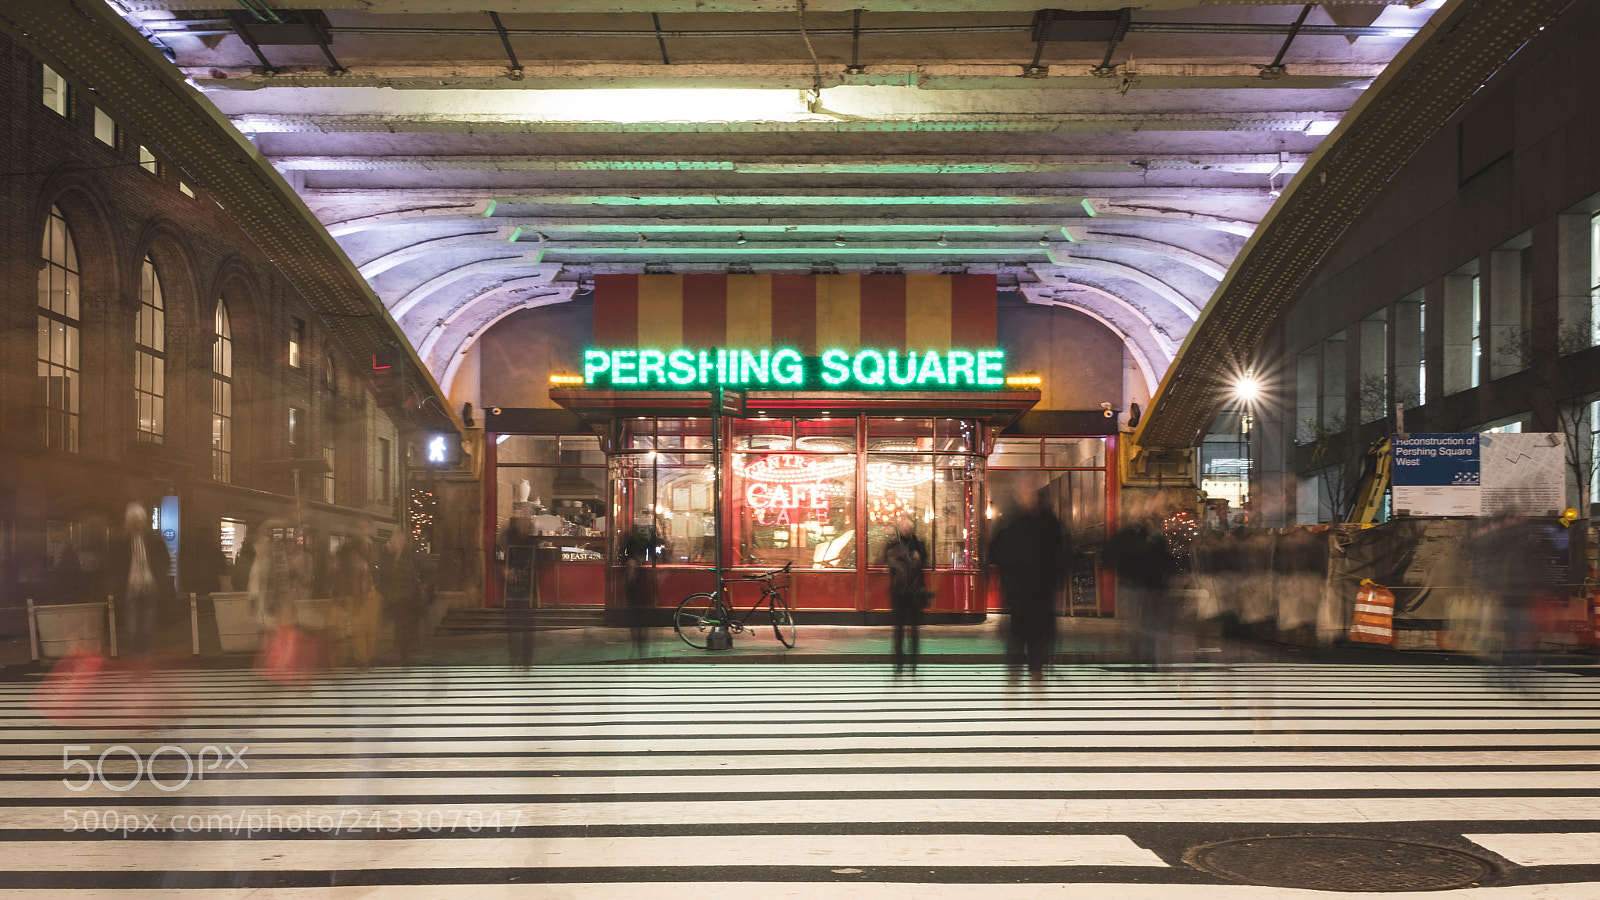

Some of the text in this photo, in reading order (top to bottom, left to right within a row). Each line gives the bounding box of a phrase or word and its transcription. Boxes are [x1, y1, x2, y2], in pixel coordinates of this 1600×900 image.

[584, 348, 1005, 386] PERSHING SQUARE
[1395, 436, 1477, 446] Reconstruction of
[1395, 447, 1473, 458] Pershing Square
[1395, 457, 1421, 466] West
